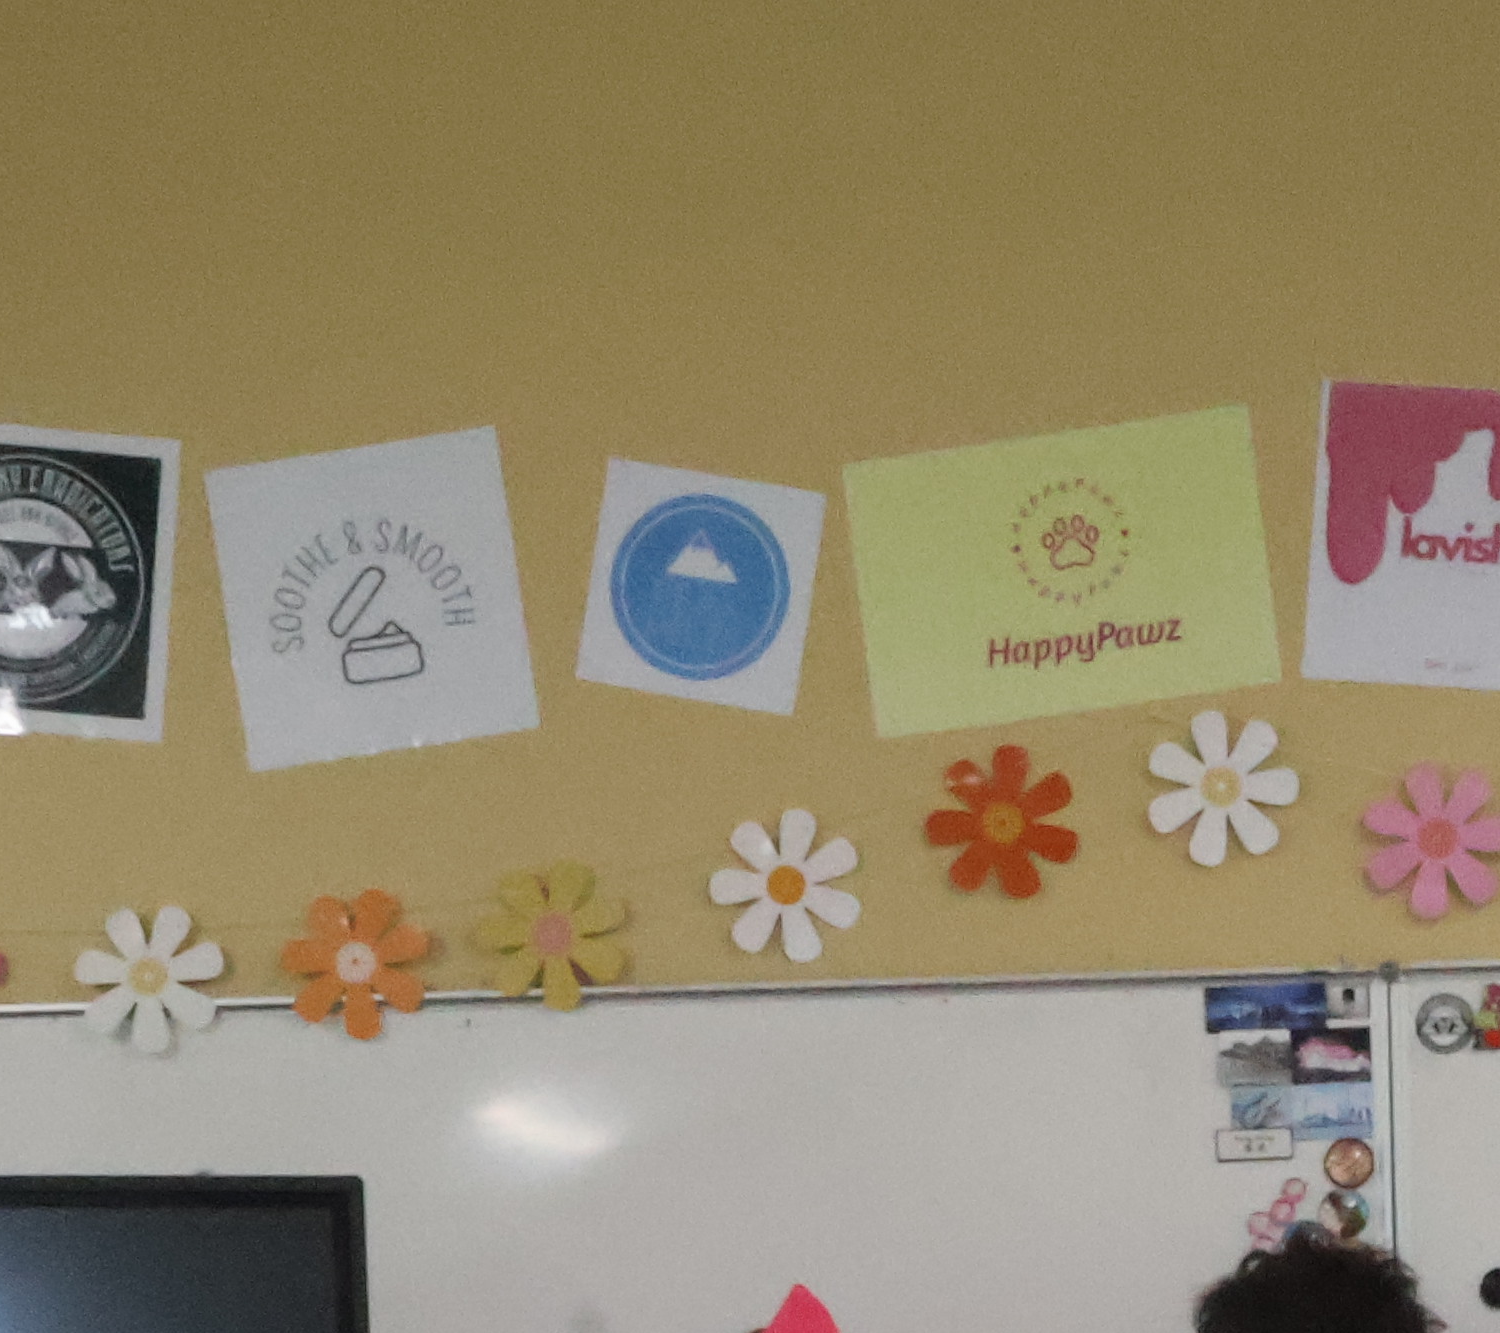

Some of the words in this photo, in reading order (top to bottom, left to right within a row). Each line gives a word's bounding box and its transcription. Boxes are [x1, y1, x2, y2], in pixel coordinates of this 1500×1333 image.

[269, 533, 340, 654] SOOTHE
[342, 520, 362, 554] &
[374, 517, 476, 626] SMOOTH
[988, 618, 1182, 670] HappyPawz
